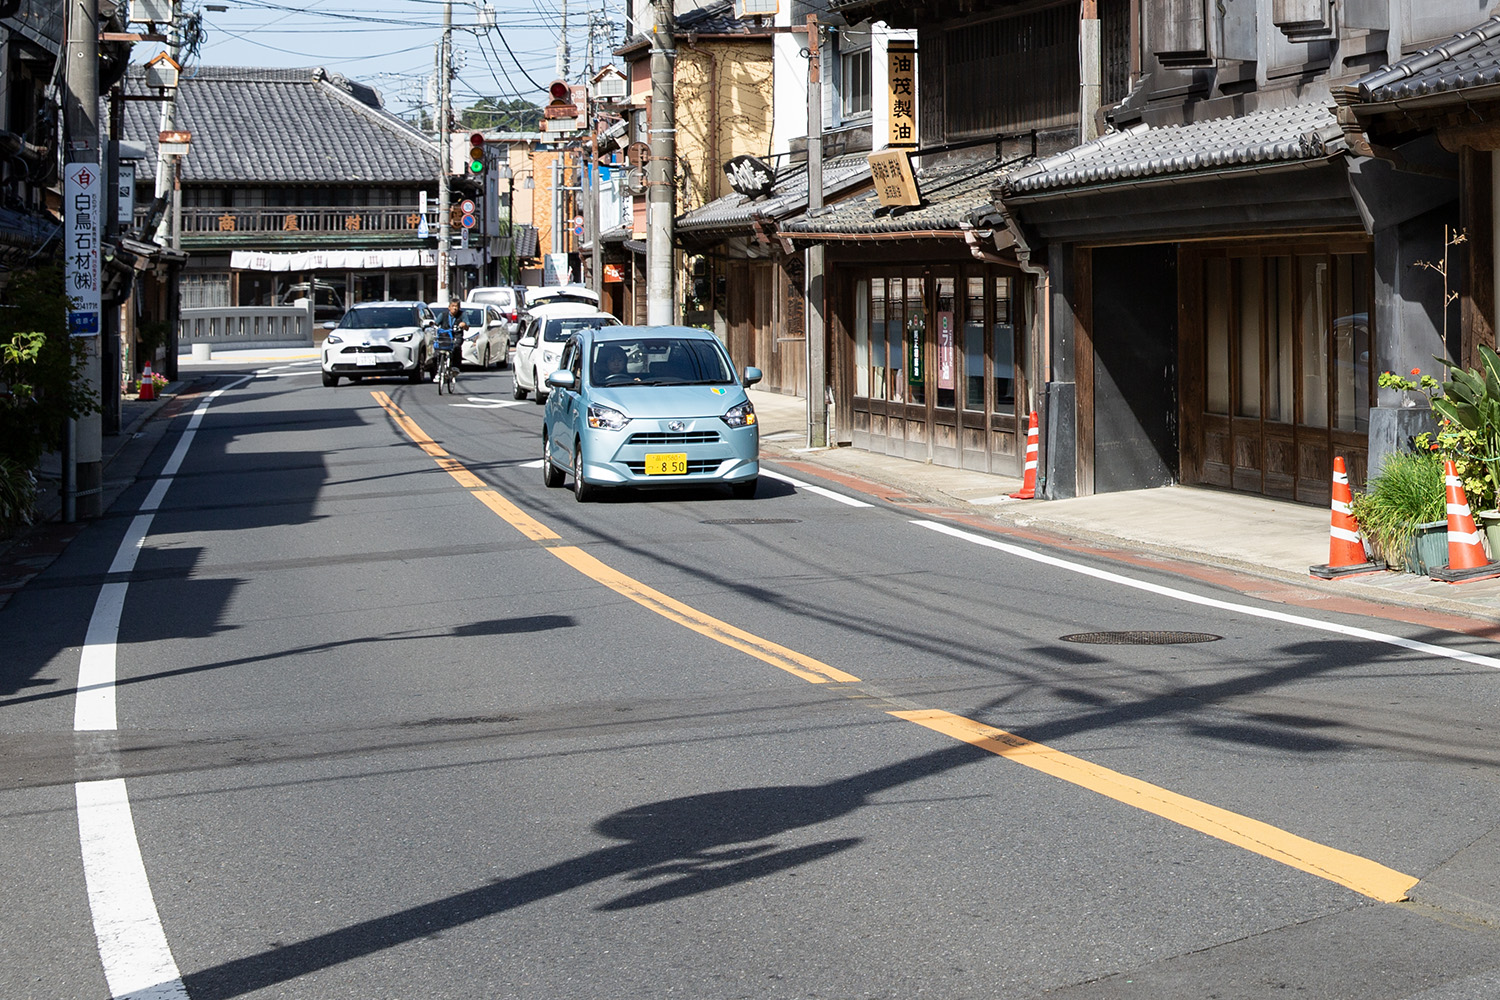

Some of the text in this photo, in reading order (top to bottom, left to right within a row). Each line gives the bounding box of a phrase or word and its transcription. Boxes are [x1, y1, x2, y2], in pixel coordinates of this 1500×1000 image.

[892, 55, 912, 141] 油茂製油
[78, 170, 90, 185] 白
[942, 329, 950, 380] ラー油
